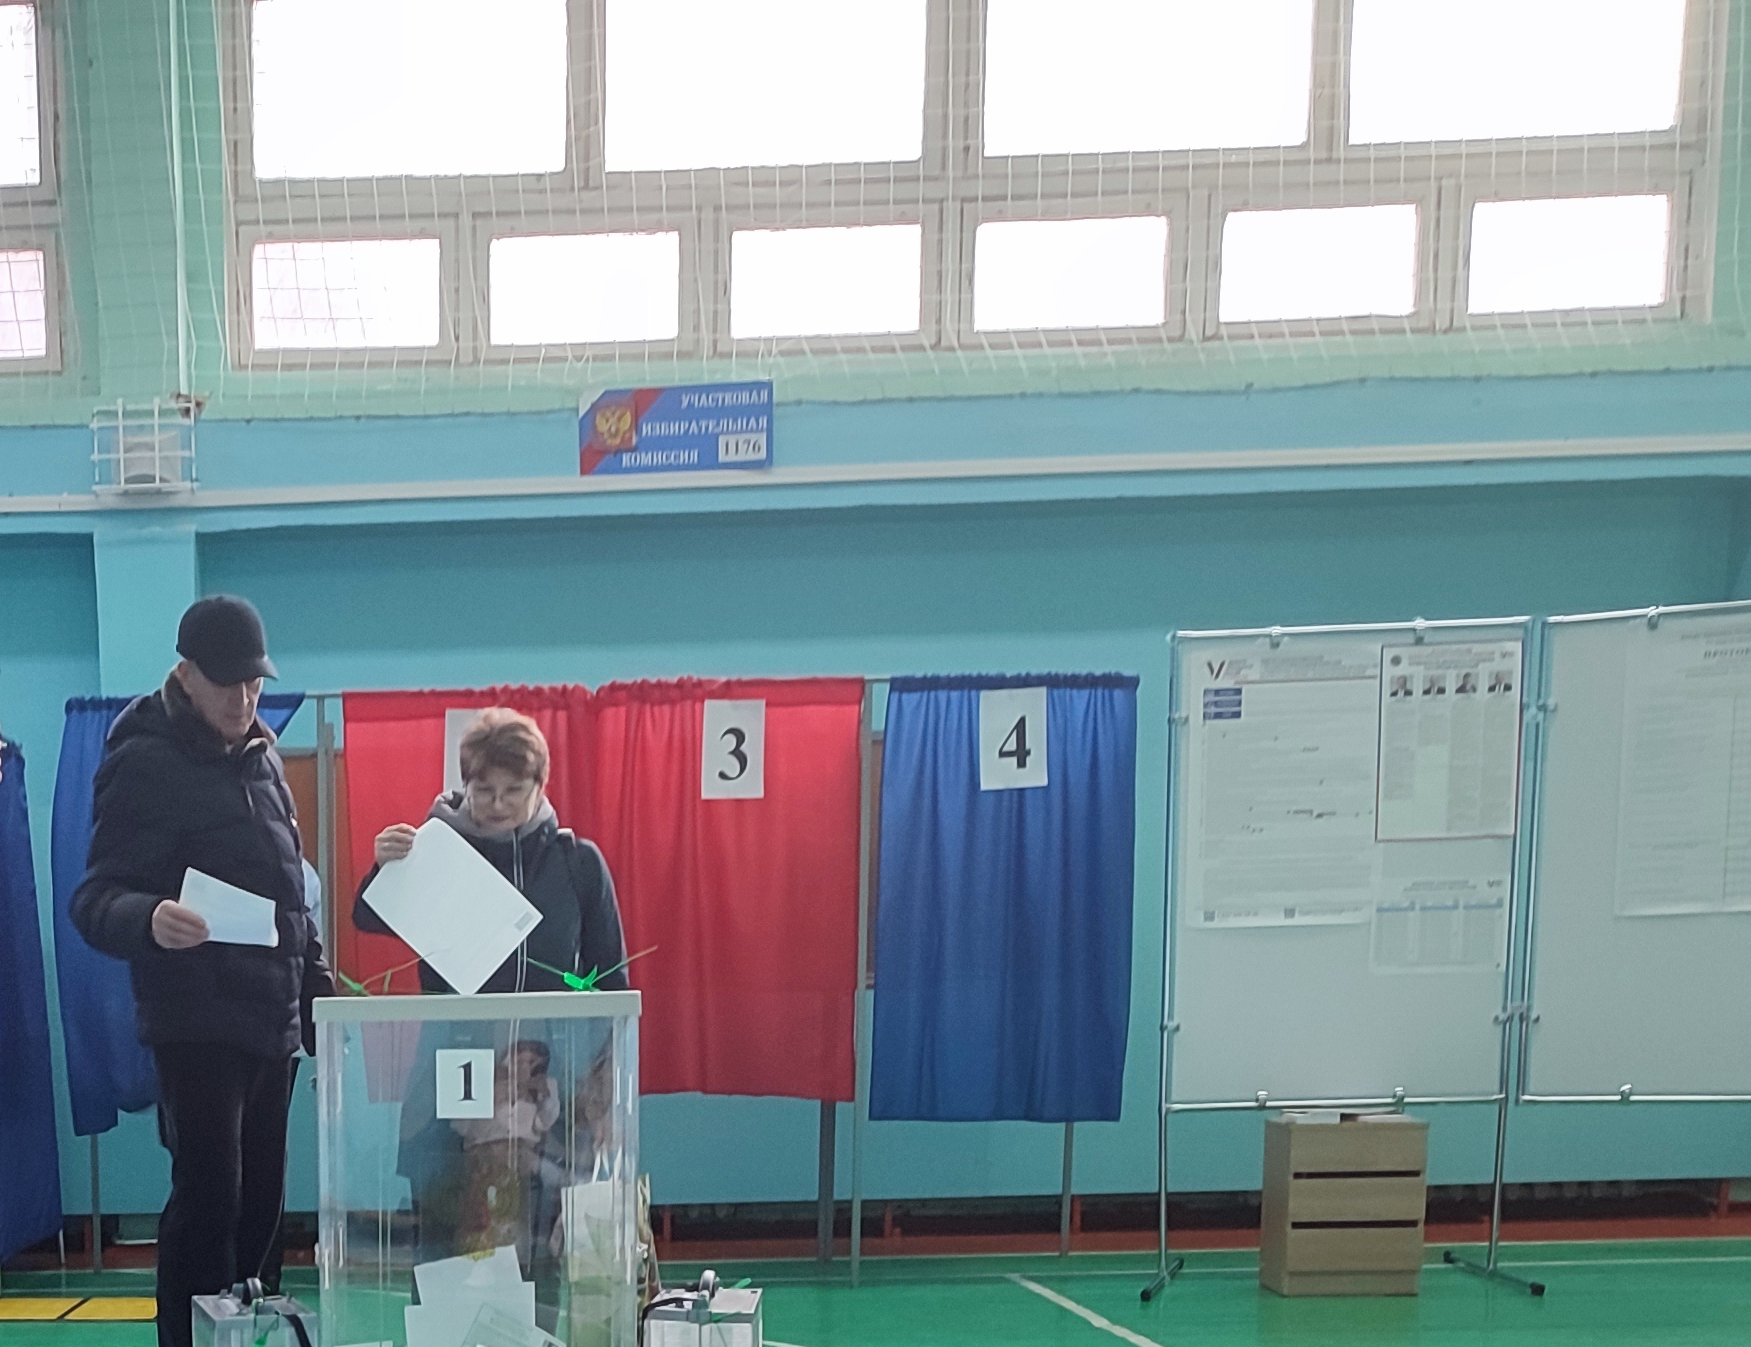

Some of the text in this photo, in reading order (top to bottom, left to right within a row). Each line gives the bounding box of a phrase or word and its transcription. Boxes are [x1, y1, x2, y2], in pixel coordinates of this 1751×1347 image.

[680, 388, 769, 410] УЧАСТКОВАЯ
[641, 414, 768, 438] ИЗБИРАТЕЛЬНАЯ
[621, 448, 699, 469] КОМИССИЯ
[723, 438, 762, 457] 1176
[718, 726, 749, 782] 3
[997, 714, 1032, 770] 4
[456, 1061, 477, 1102] 1
